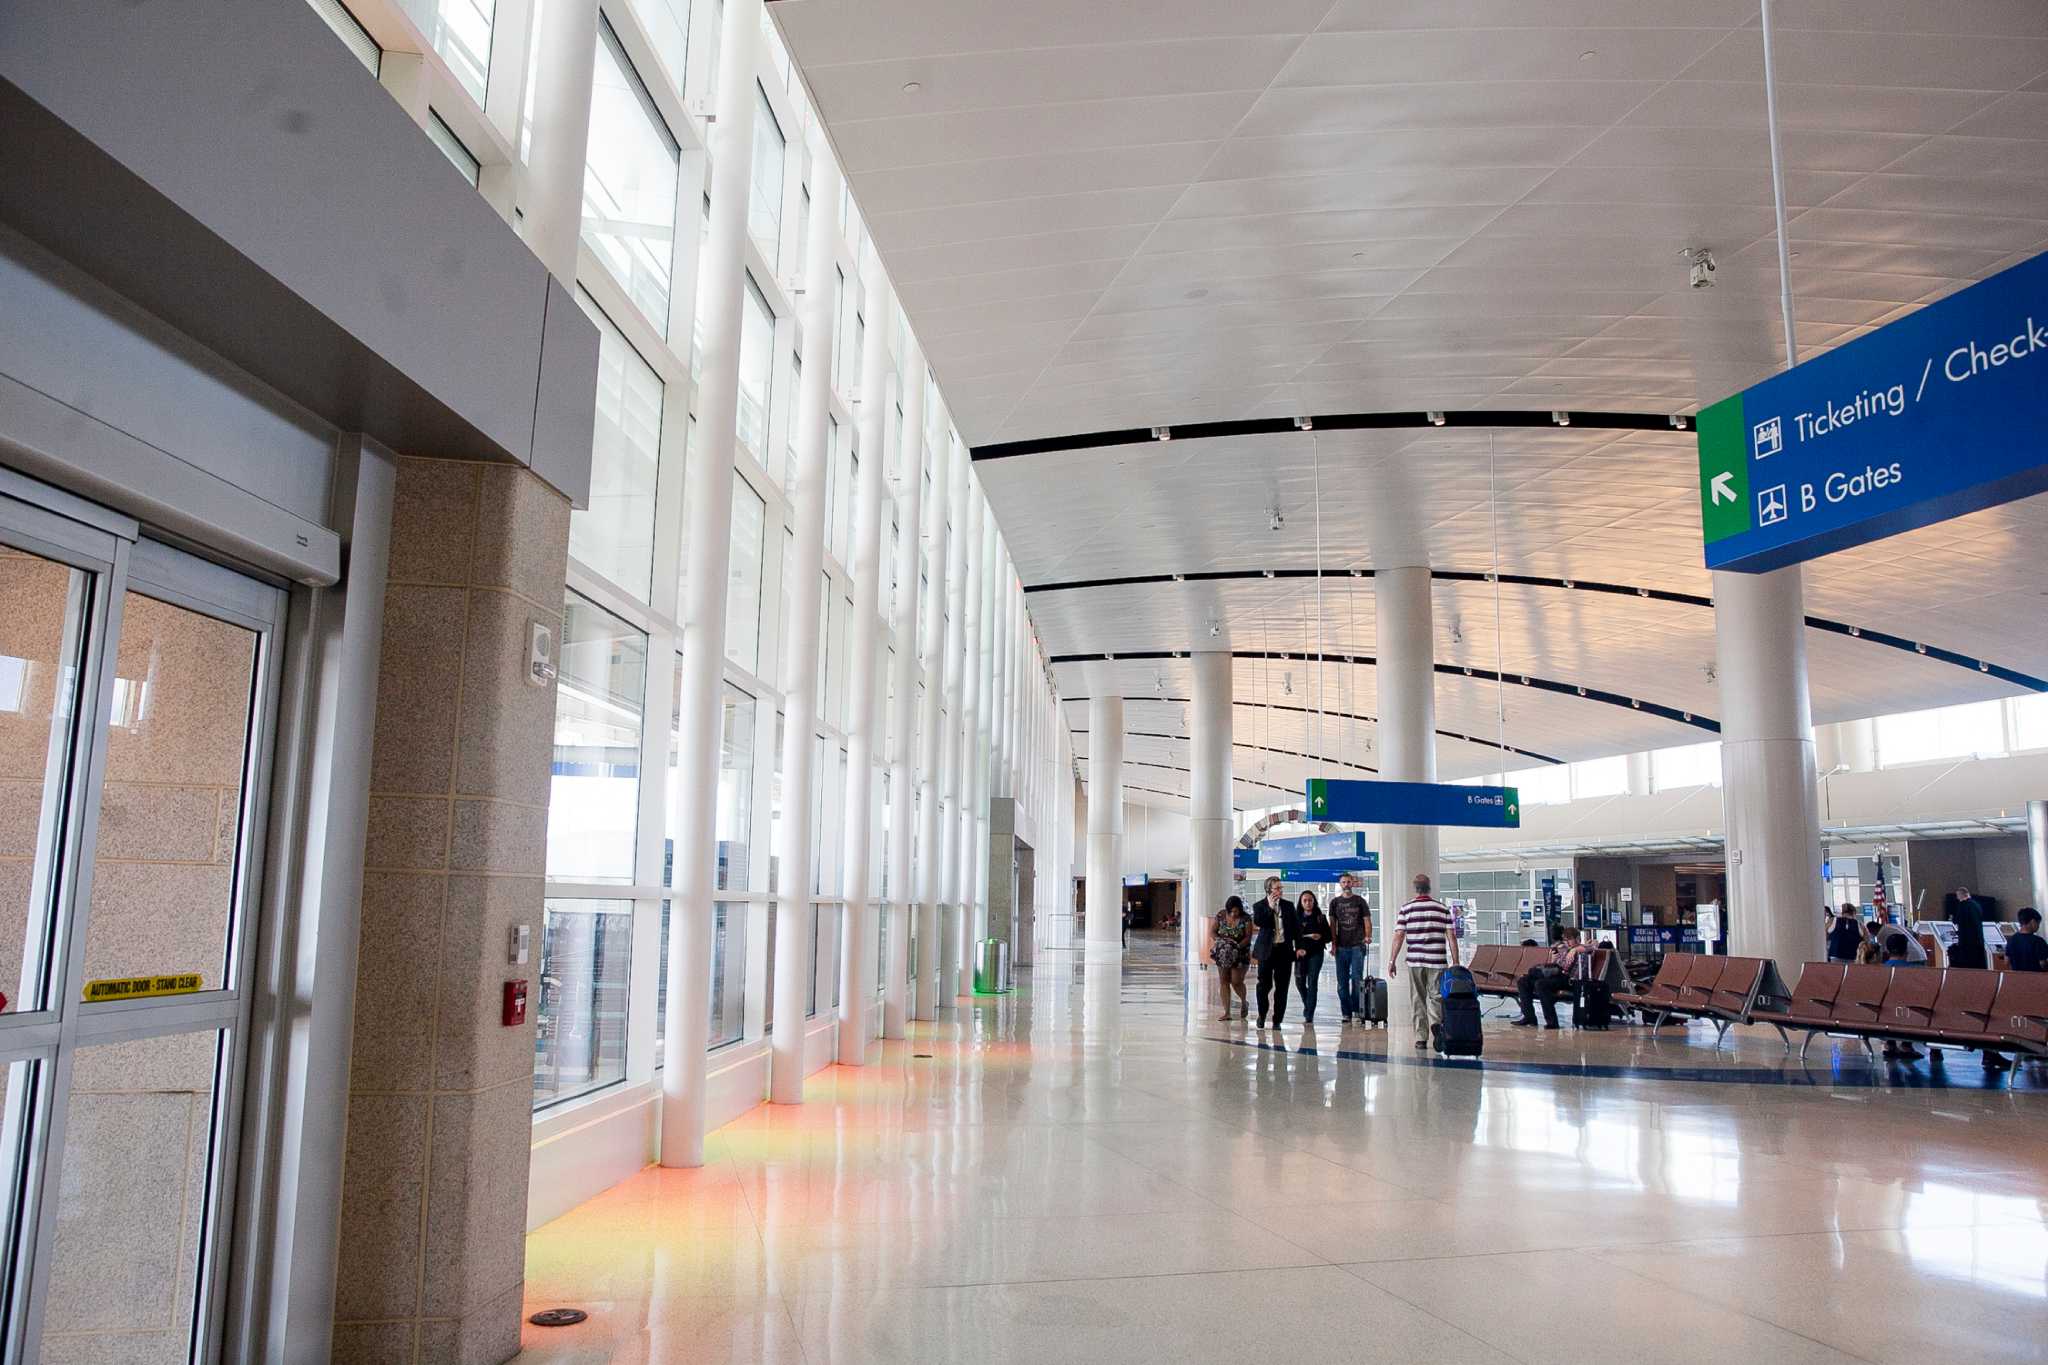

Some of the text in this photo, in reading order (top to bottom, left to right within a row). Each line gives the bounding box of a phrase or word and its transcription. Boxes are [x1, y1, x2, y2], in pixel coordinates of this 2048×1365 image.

[1795, 384, 1905, 442] Ticketing
[1915, 358, 1932, 402] /
[1800, 462, 1903, 513] B Gates
[1474, 795, 1494, 805] Gates
[90, 980, 131, 997] AUTOMATIC
[132, 979, 151, 993] DOOR
[156, 977, 177, 991] STAND
[178, 976, 199, 989] CLEAR
